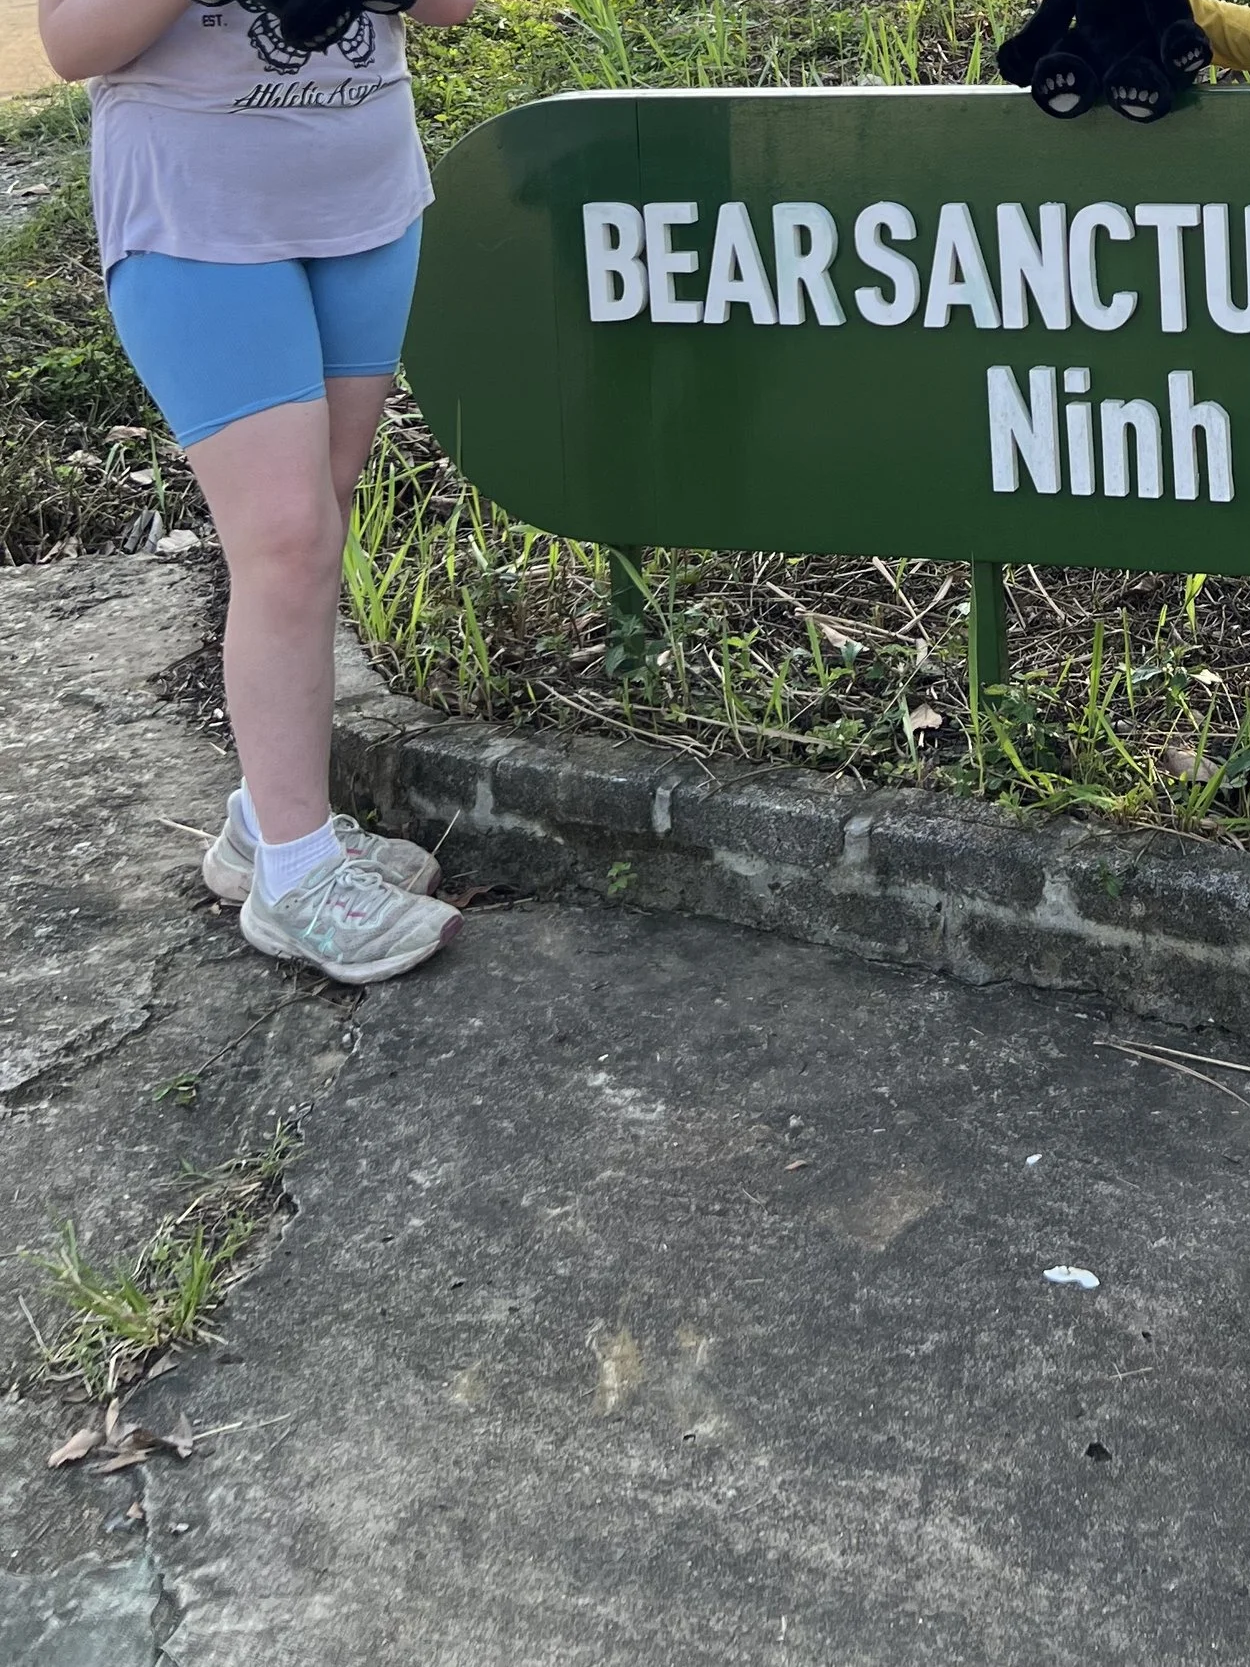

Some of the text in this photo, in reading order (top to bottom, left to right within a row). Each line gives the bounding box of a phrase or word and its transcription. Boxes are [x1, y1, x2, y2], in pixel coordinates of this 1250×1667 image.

[202, 14, 228, 27] EST.
[232, 80, 325, 109] Athletic
[581, 201, 847, 327] BEAR
[985, 364, 1236, 503] Ninh
